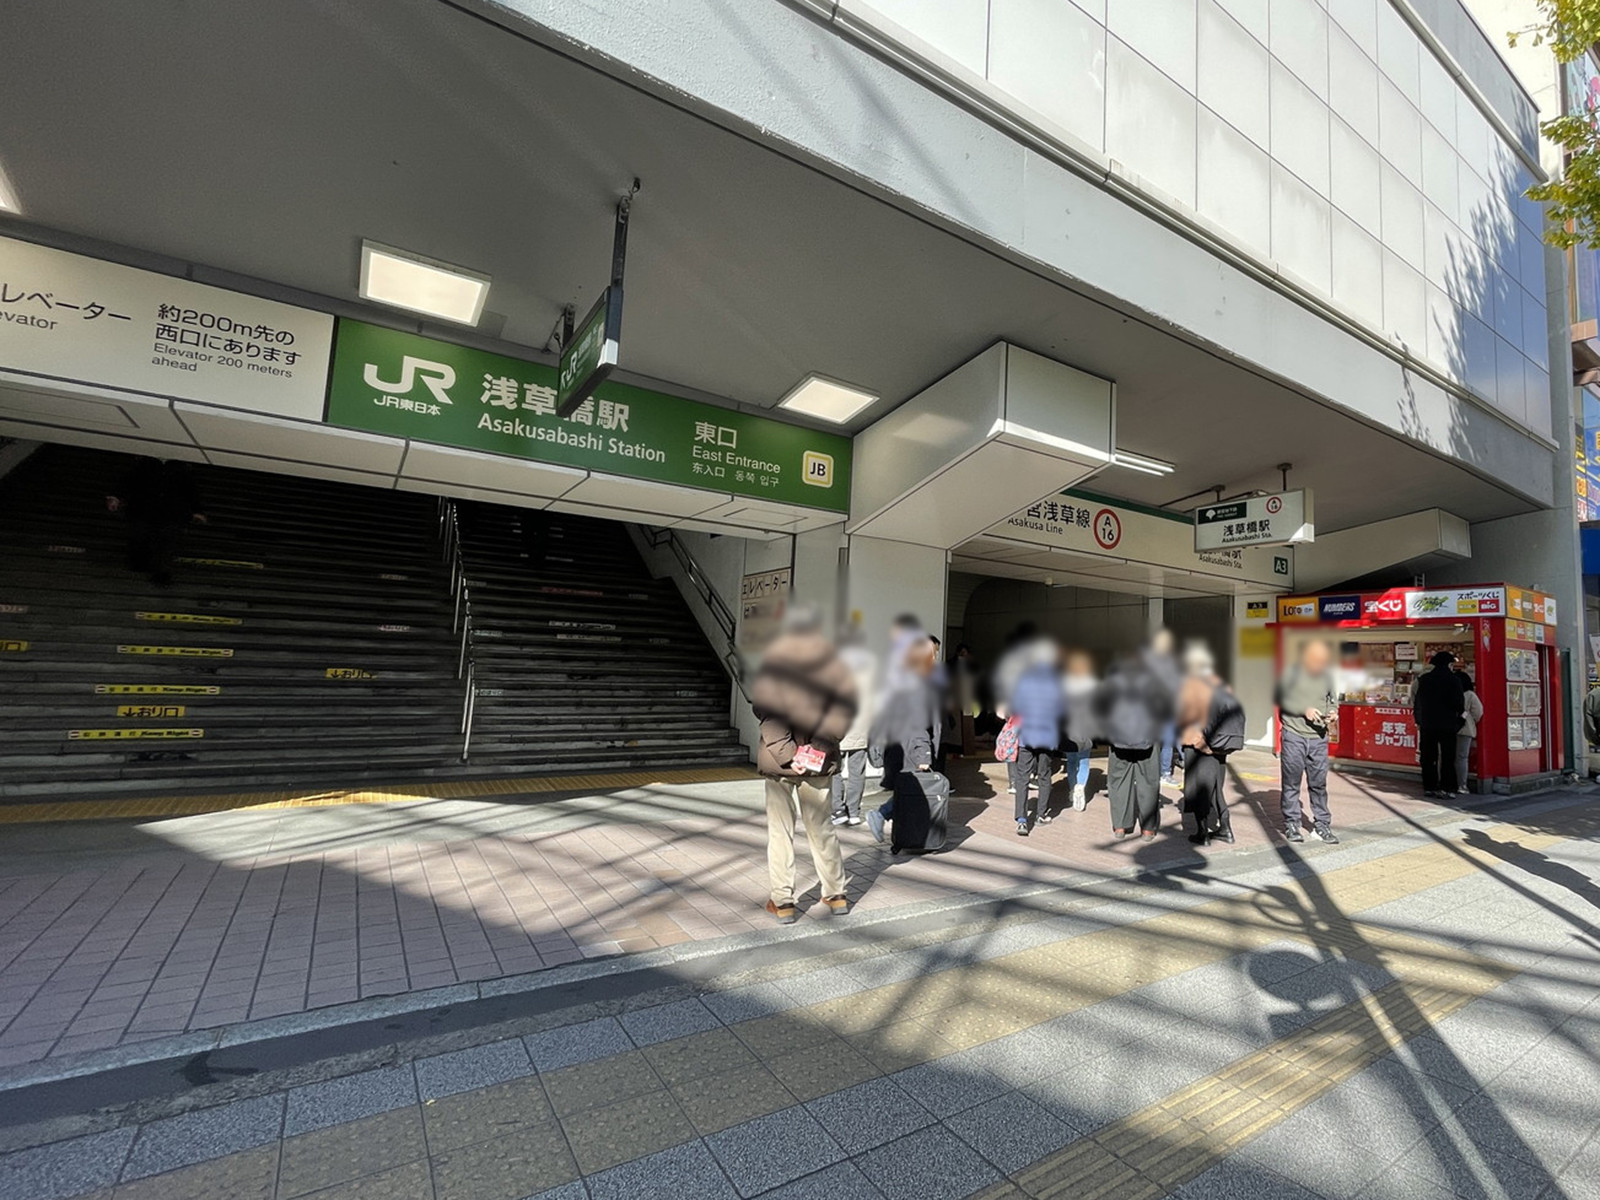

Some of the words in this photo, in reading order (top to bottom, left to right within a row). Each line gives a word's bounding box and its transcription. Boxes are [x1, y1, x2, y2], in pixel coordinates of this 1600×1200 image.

[1, 283, 131, 320] レベーター
[0, 311, 58, 330] vator
[157, 303, 295, 345] 約200m先の
[155, 322, 302, 366] 西口にあります
[151, 356, 198, 372] ahead
[153, 343, 213, 363] Elevator
[217, 355, 243, 369] 200
[247, 363, 293, 378] meters
[363, 355, 457, 405] JR
[373, 395, 441, 416] JR東日本
[477, 412, 603, 451] Asakusabashi
[608, 437, 666, 463] Station
[694, 421, 737, 449] 東口
[692, 445, 722, 462] East
[725, 452, 781, 474] Entrance
[692, 462, 726, 478] 东入口
[809, 462, 827, 477] JB
[735, 470, 756, 484] 동쪽
[760, 475, 780, 488] 입구
[1046, 522, 1063, 535] Line
[1104, 516, 1112, 527] A
[1223, 519, 1271, 537] 浅草橋駅
[1102, 528, 1115, 541] 16
[1275, 560, 1287, 573] A3
[1457, 591, 1500, 600] スポーツくじ
[1364, 599, 1403, 613] 宝くじ
[136, 706, 178, 718] おり口
[1382, 721, 1407, 735] 年末
